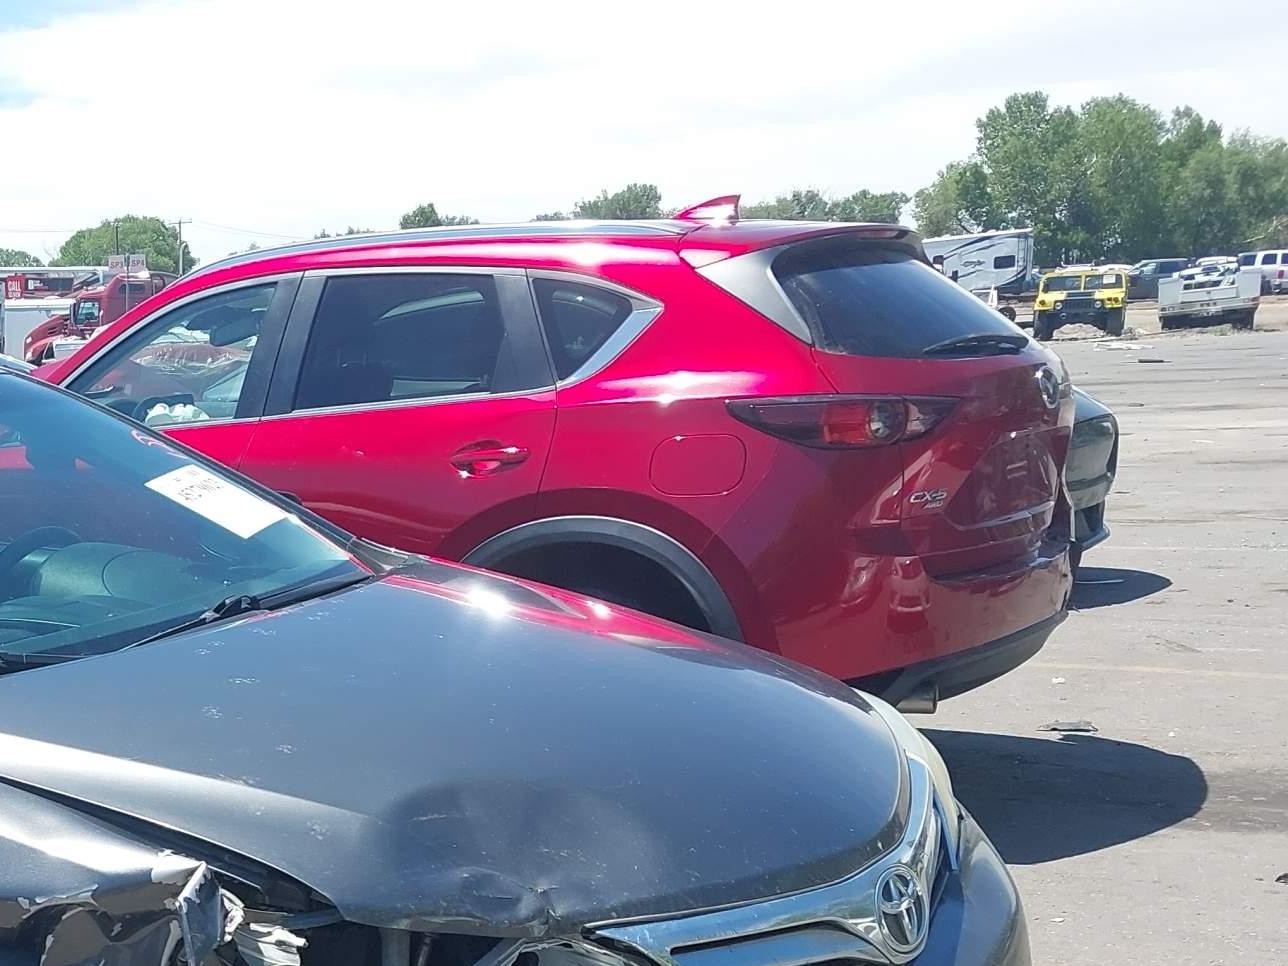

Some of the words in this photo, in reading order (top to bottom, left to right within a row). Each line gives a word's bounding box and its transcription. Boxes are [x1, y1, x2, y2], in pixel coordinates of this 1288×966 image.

[131, 259, 145, 267] SP4
[7, 280, 22, 292] CALL
[909, 489, 948, 503] CX-5
